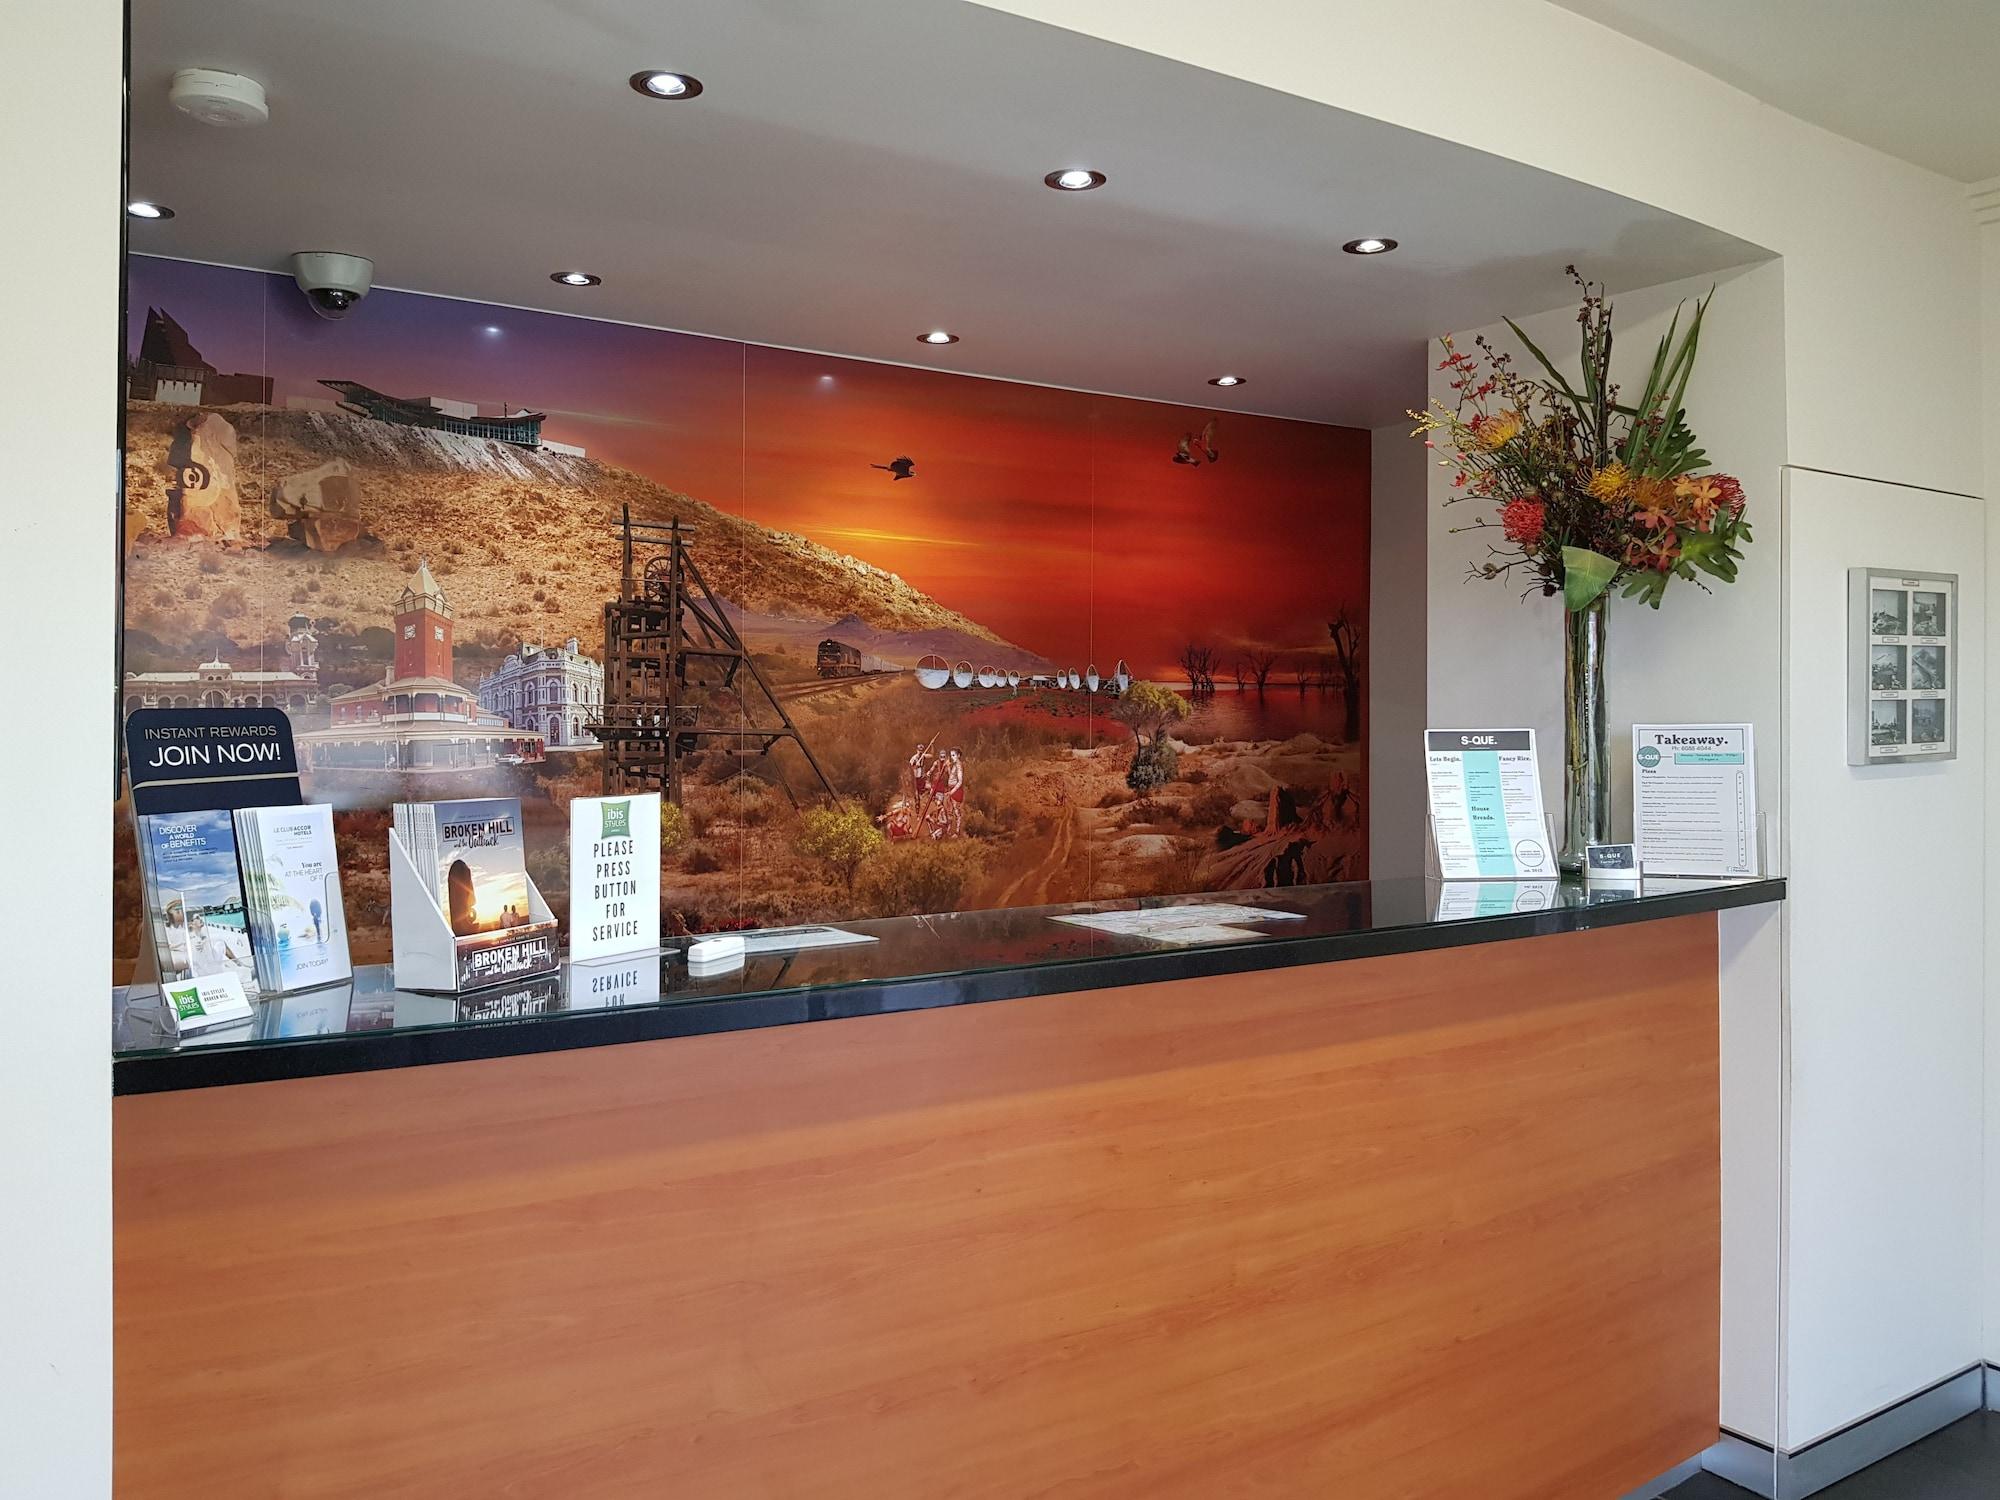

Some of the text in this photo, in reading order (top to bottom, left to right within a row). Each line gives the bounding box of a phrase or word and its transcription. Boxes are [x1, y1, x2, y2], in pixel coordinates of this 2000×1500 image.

[144, 725, 278, 740] INSTANT REWARDS
[1460, 735, 1498, 746] S-QUE.
[1654, 734, 1729, 747] Takeaway.
[149, 742, 282, 768] JOIN NOW!
[607, 807, 624, 820] ibis
[158, 824, 198, 835] DISCOVER
[444, 820, 513, 839] BROKEN HILL
[169, 837, 207, 849] BENEFITS
[593, 839, 635, 858] PLEASE
[596, 860, 631, 878] PRESS
[594, 880, 637, 900] BUTTON
[605, 902, 626, 919] FOR
[592, 920, 639, 942] SERVICE
[474, 940, 546, 968] BROKEN HILL
[178, 994, 195, 1005] ibis
